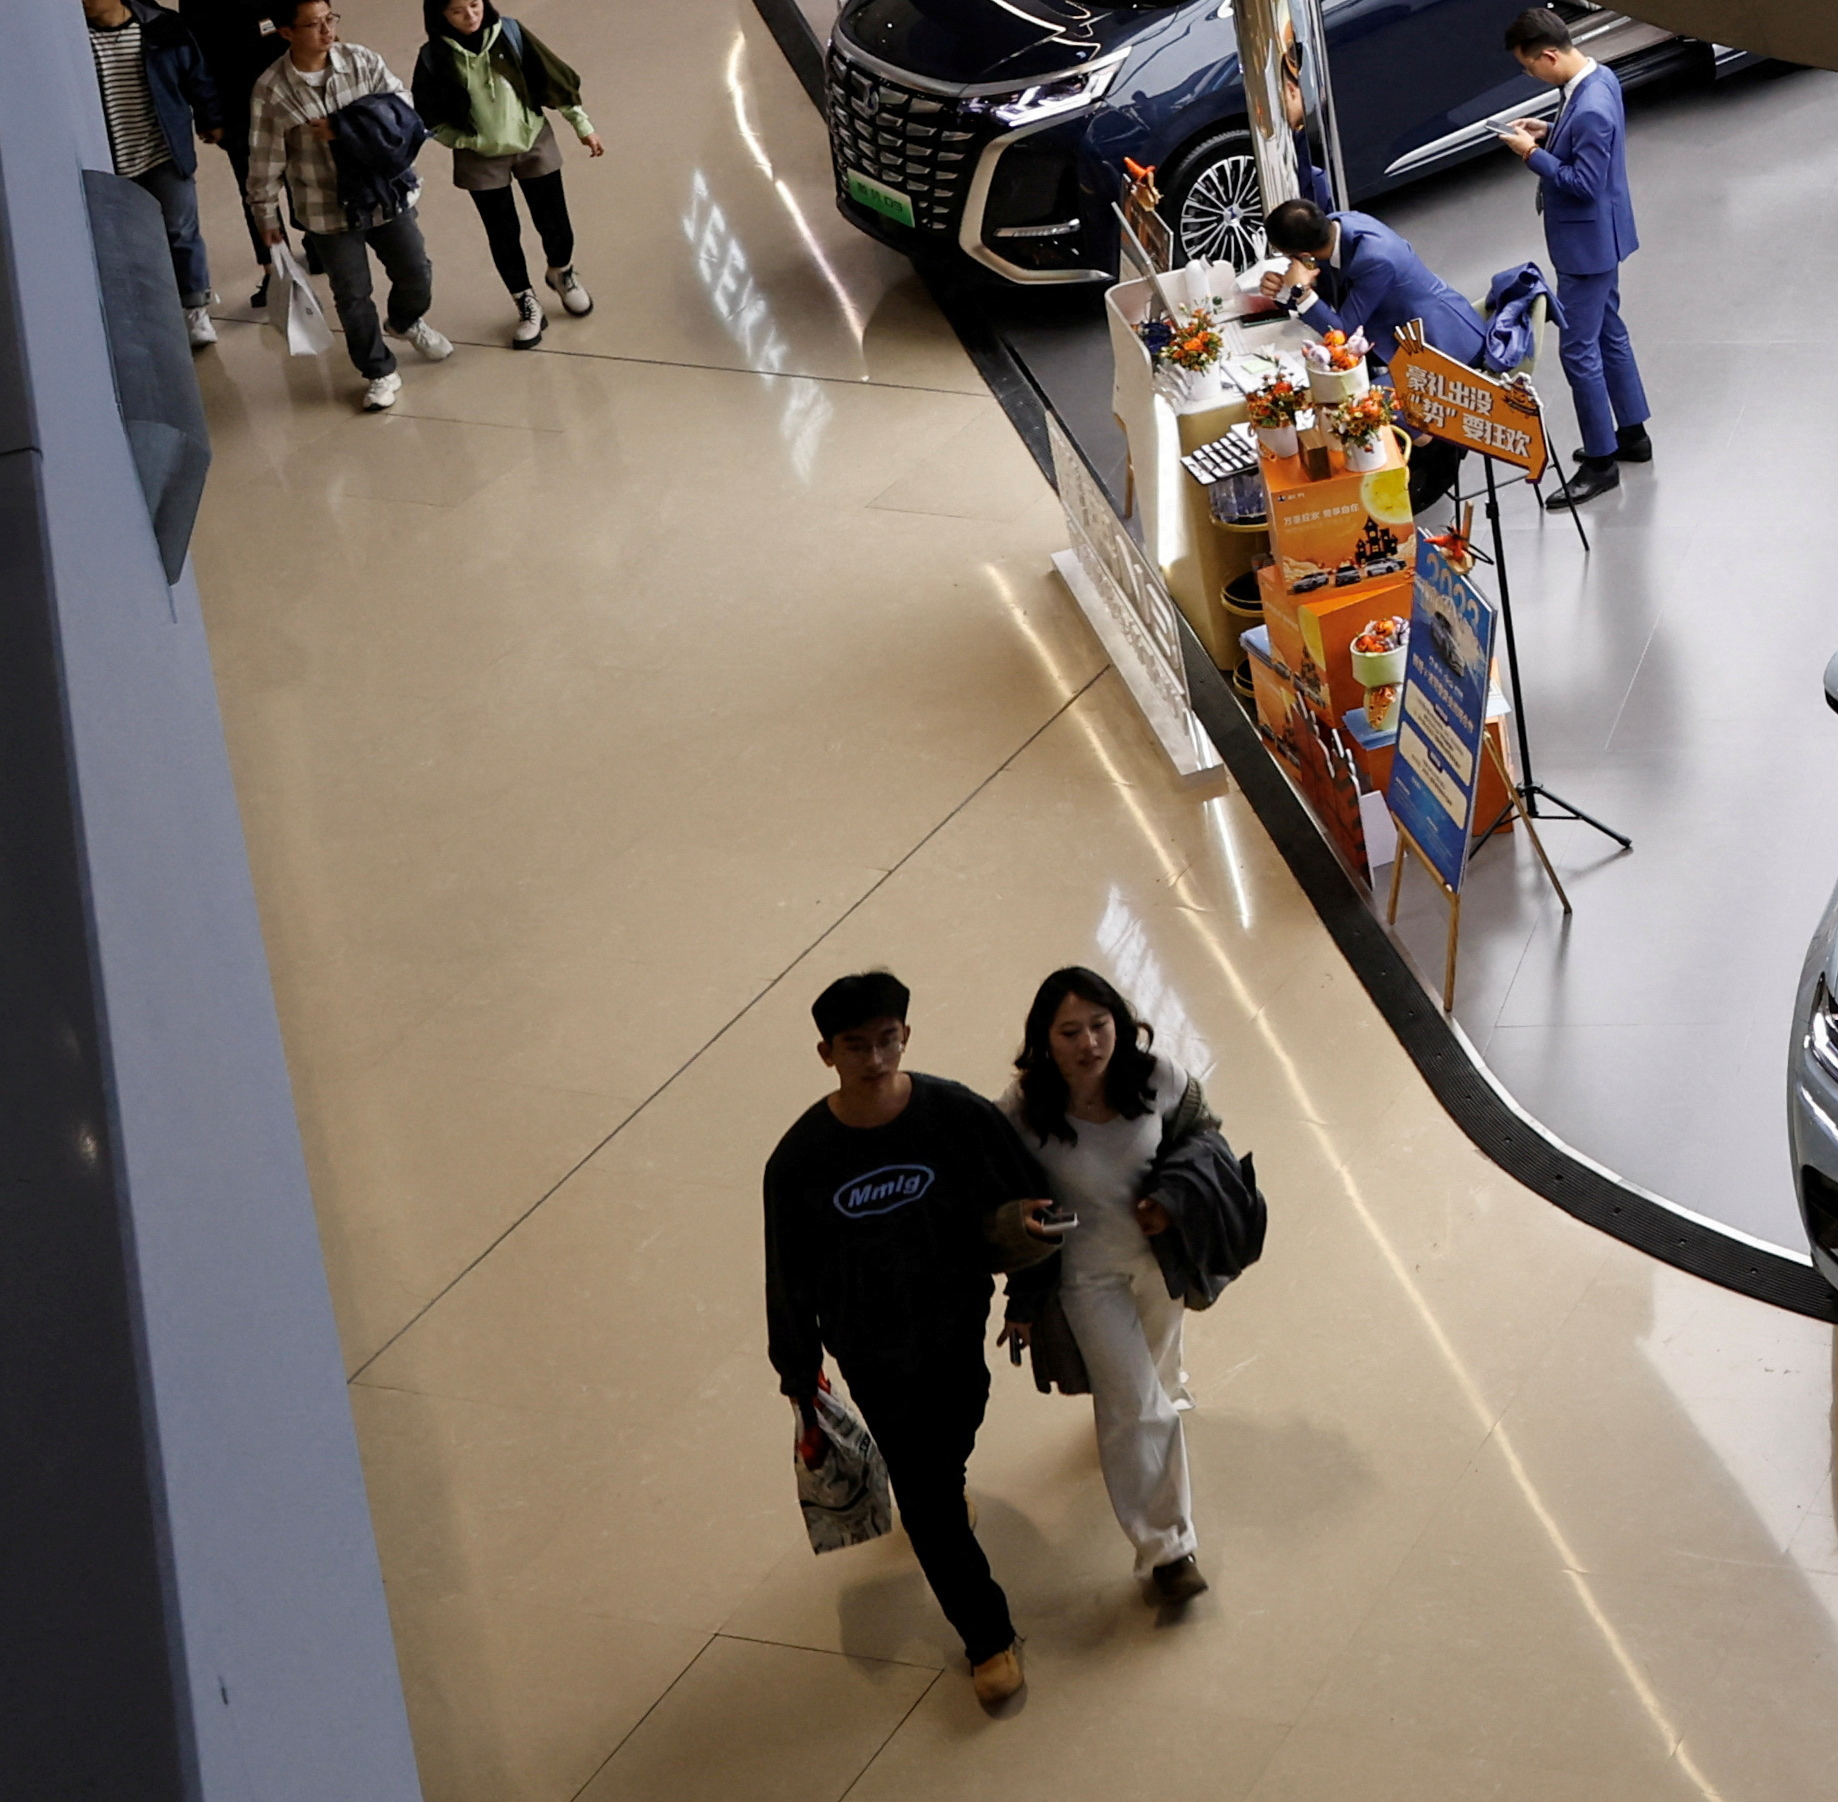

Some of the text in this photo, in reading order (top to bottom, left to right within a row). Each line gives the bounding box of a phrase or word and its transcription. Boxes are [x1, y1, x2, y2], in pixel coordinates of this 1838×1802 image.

[1405, 363, 1493, 417] 豪礼出没
[1461, 411, 1532, 458] 要狂欢
